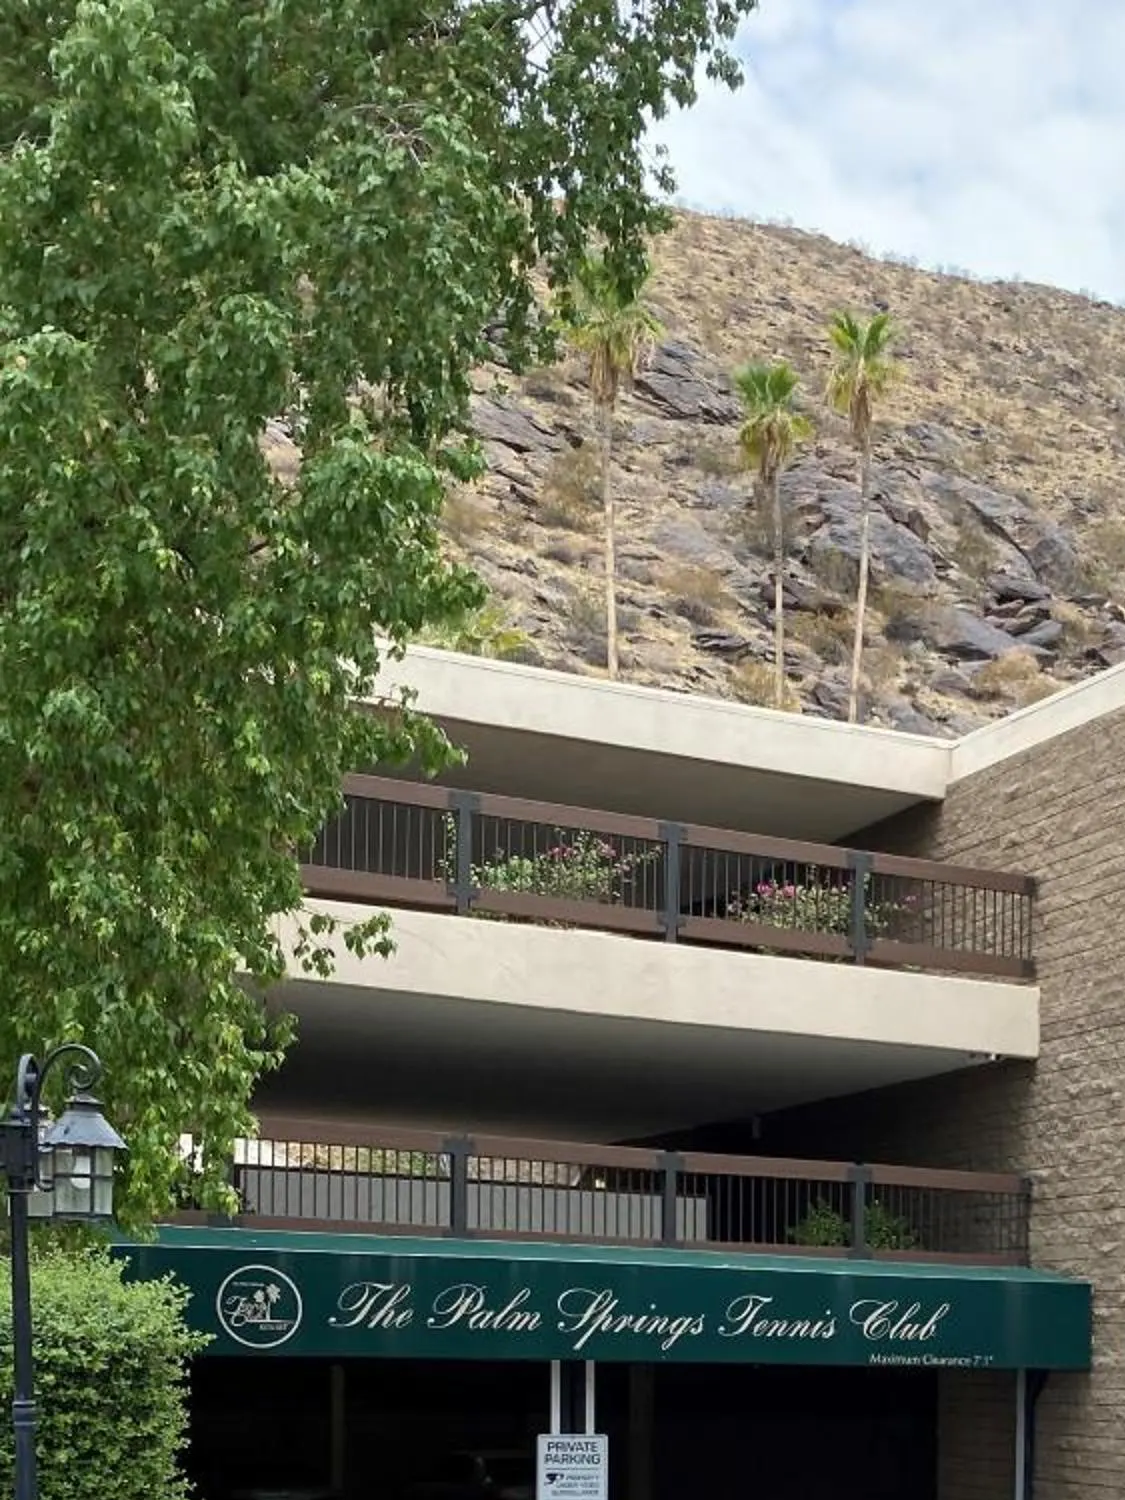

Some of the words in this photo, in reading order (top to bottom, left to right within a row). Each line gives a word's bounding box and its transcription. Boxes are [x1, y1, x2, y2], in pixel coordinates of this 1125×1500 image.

[328, 1282, 413, 1328] The
[427, 1284, 542, 1329] Palm
[557, 1288, 704, 1351] Springs
[717, 1295, 838, 1338] Tennis
[849, 1299, 951, 1341] Club
[870, 1353, 921, 1365] Maximum
[547, 1441, 598, 1452] PRIVATE
[544, 1453, 601, 1465] PARKING
